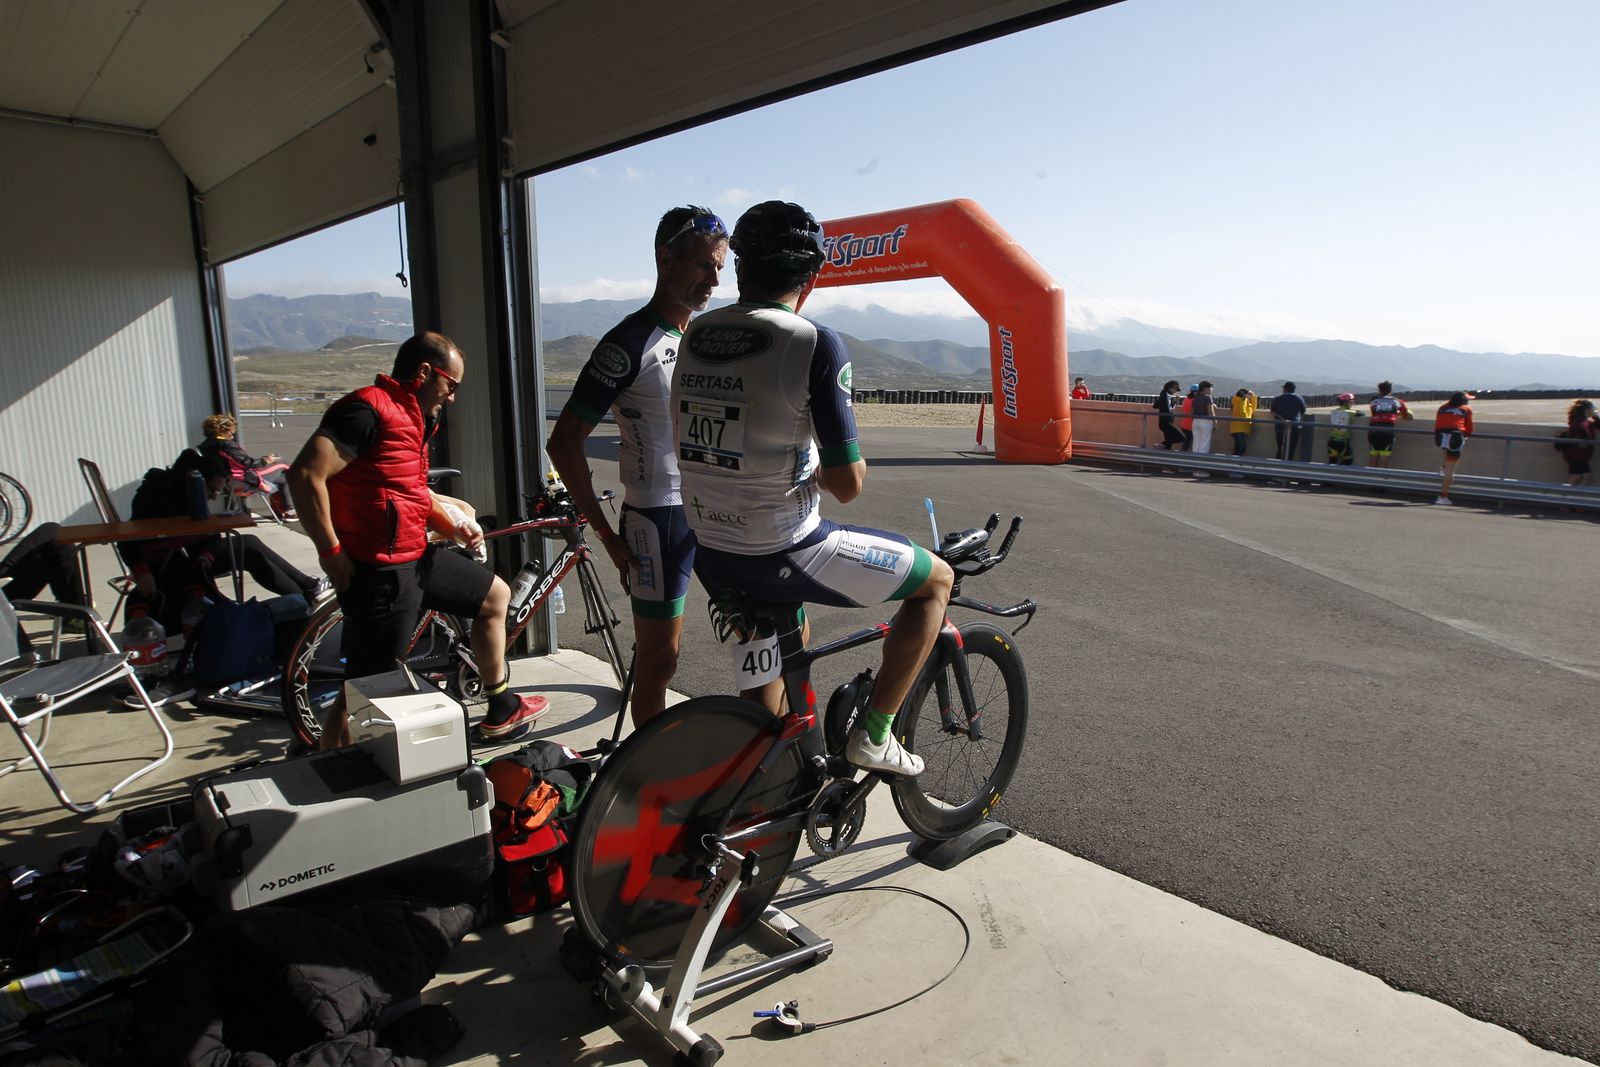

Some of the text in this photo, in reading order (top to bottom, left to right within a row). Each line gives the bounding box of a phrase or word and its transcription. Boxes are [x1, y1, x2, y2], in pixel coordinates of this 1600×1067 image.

[698, 341, 752, 354] ROVER
[661, 357, 677, 366] VIAT
[998, 326, 1018, 418] InfiSport
[680, 373, 744, 392] SERTASA
[688, 415, 726, 448] 407
[708, 510, 748, 526] aecc
[862, 548, 902, 570] ALEX
[516, 551, 576, 623] ORBEA
[741, 640, 779, 676] 407
[278, 863, 335, 887] DOMETIC
[703, 877, 729, 912] Tacx
